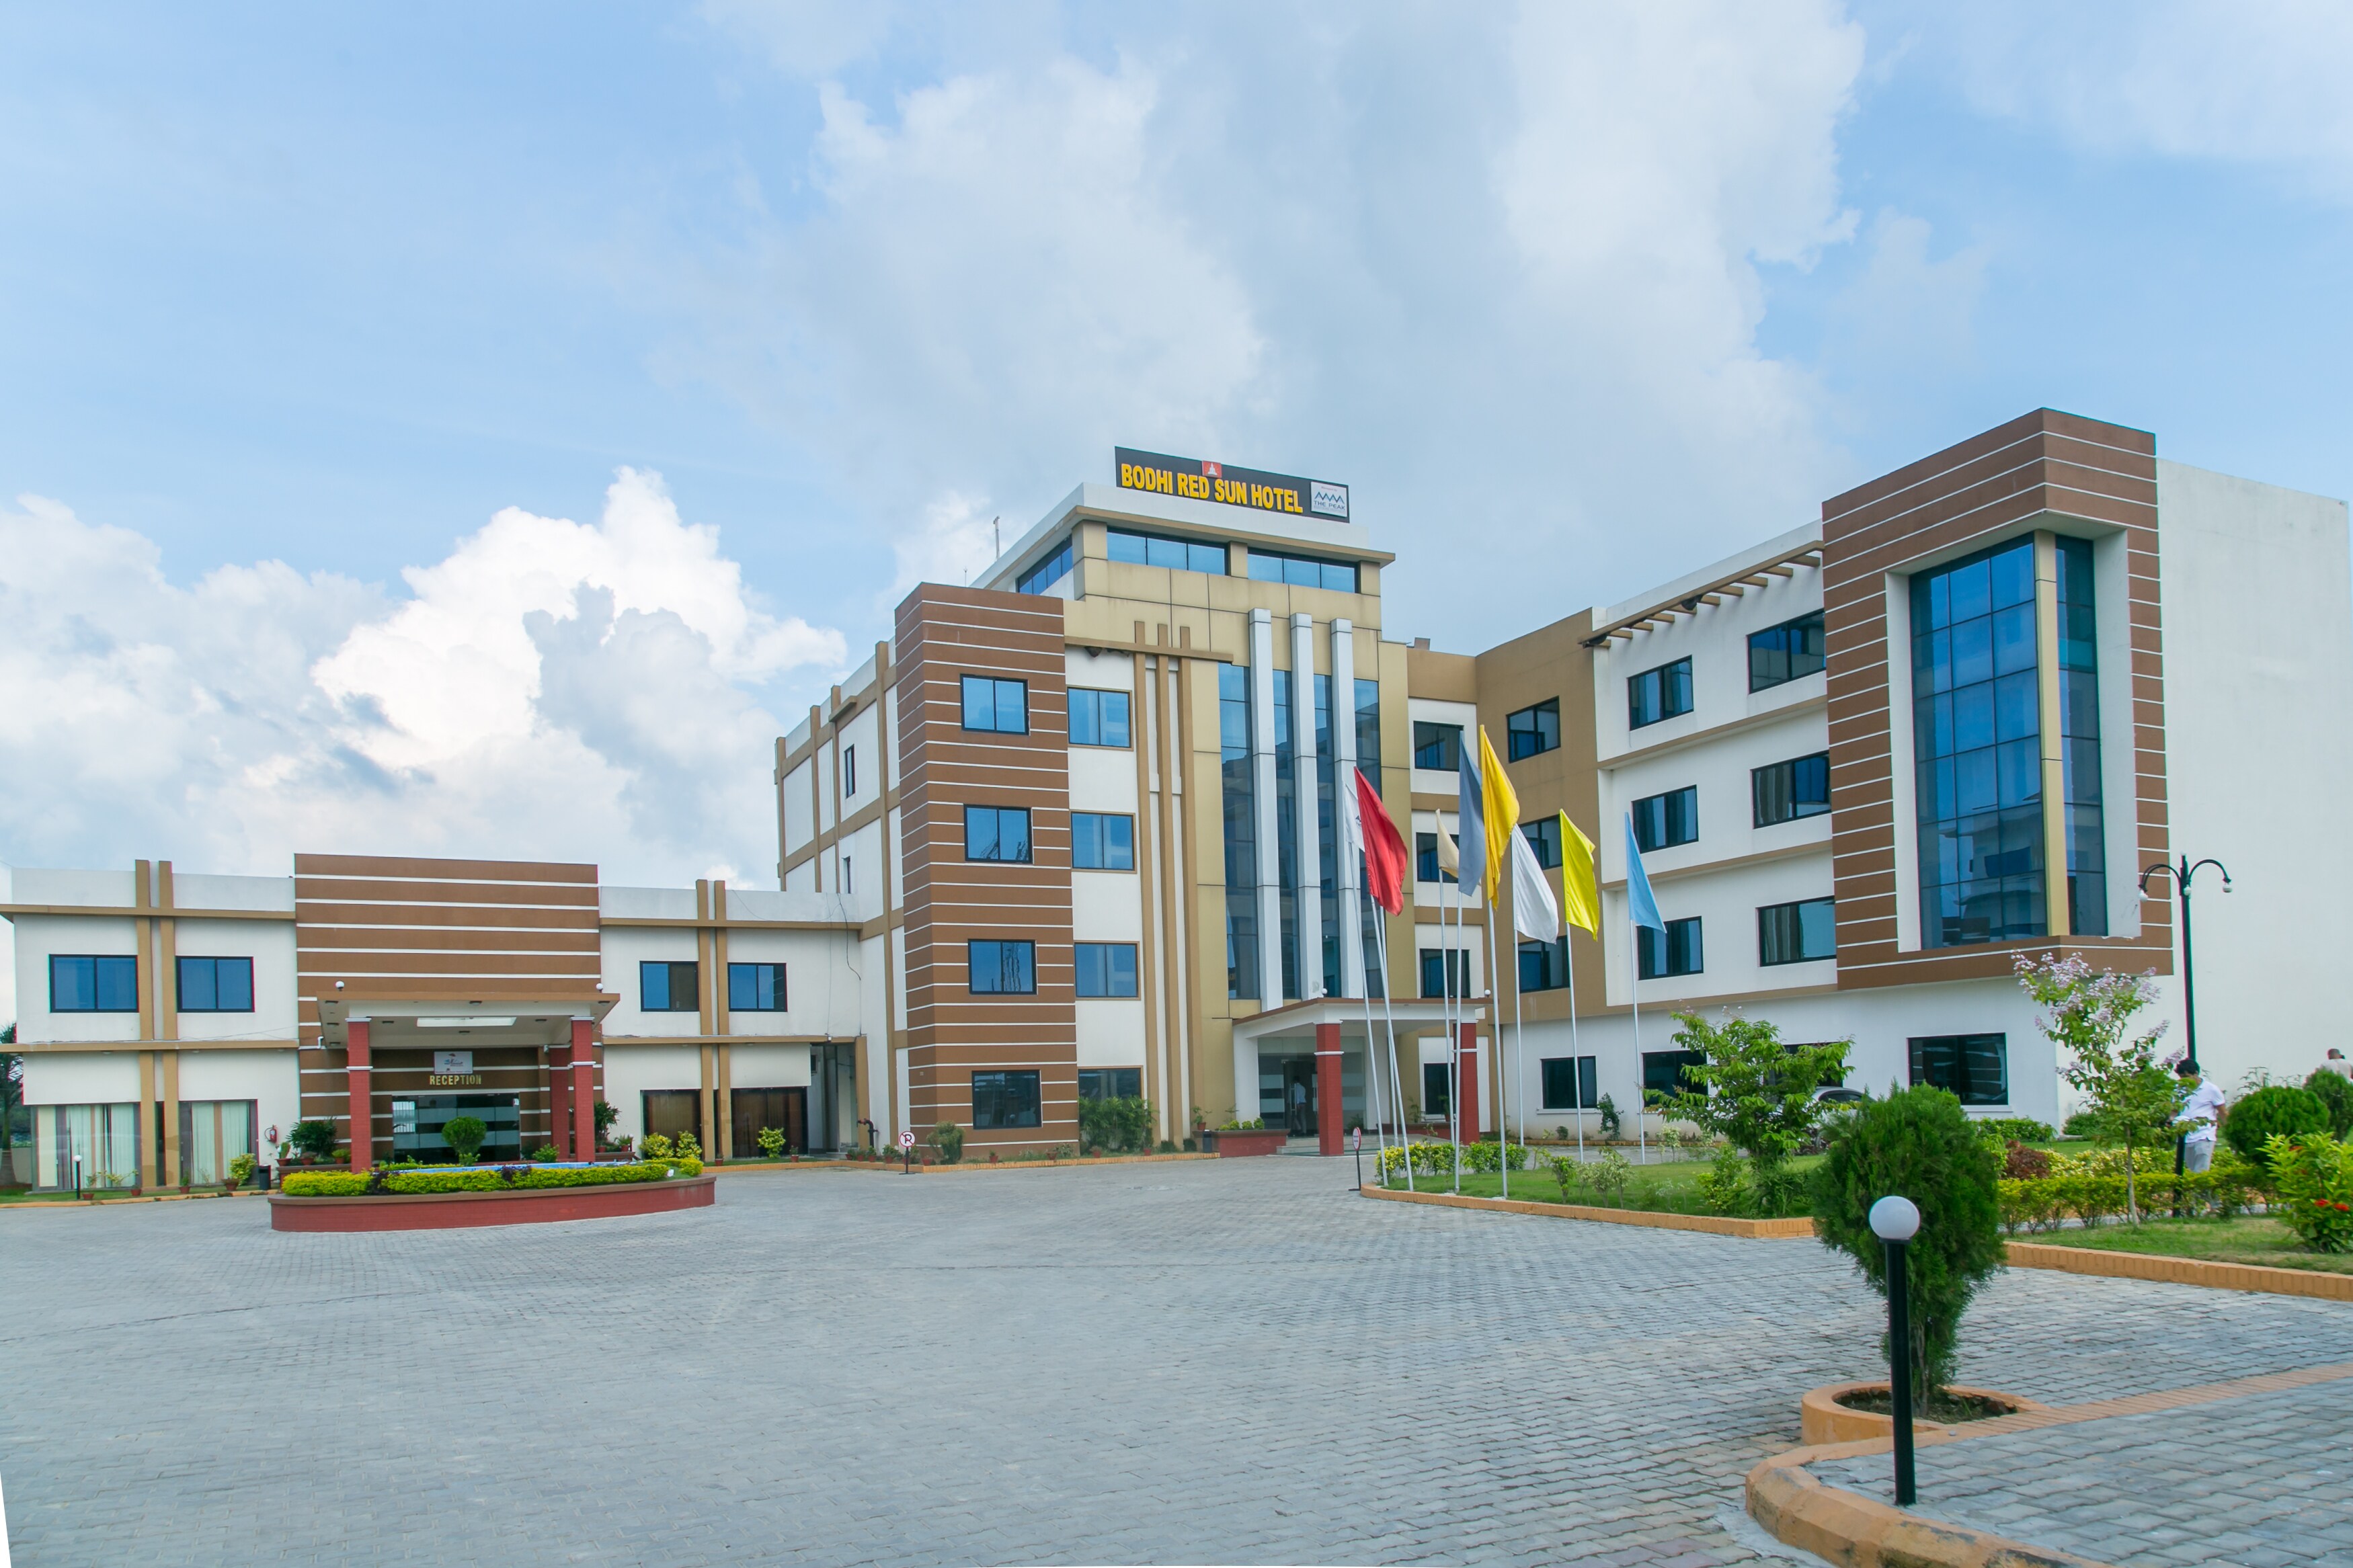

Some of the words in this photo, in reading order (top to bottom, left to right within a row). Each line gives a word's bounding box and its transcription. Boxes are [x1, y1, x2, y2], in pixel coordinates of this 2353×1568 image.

[1121, 463, 1173, 495] BODHI
[1177, 472, 1209, 499] RED
[1214, 479, 1247, 505] SUN
[1250, 483, 1303, 513] HOTEL
[430, 1075, 481, 1085] RECEPTION
